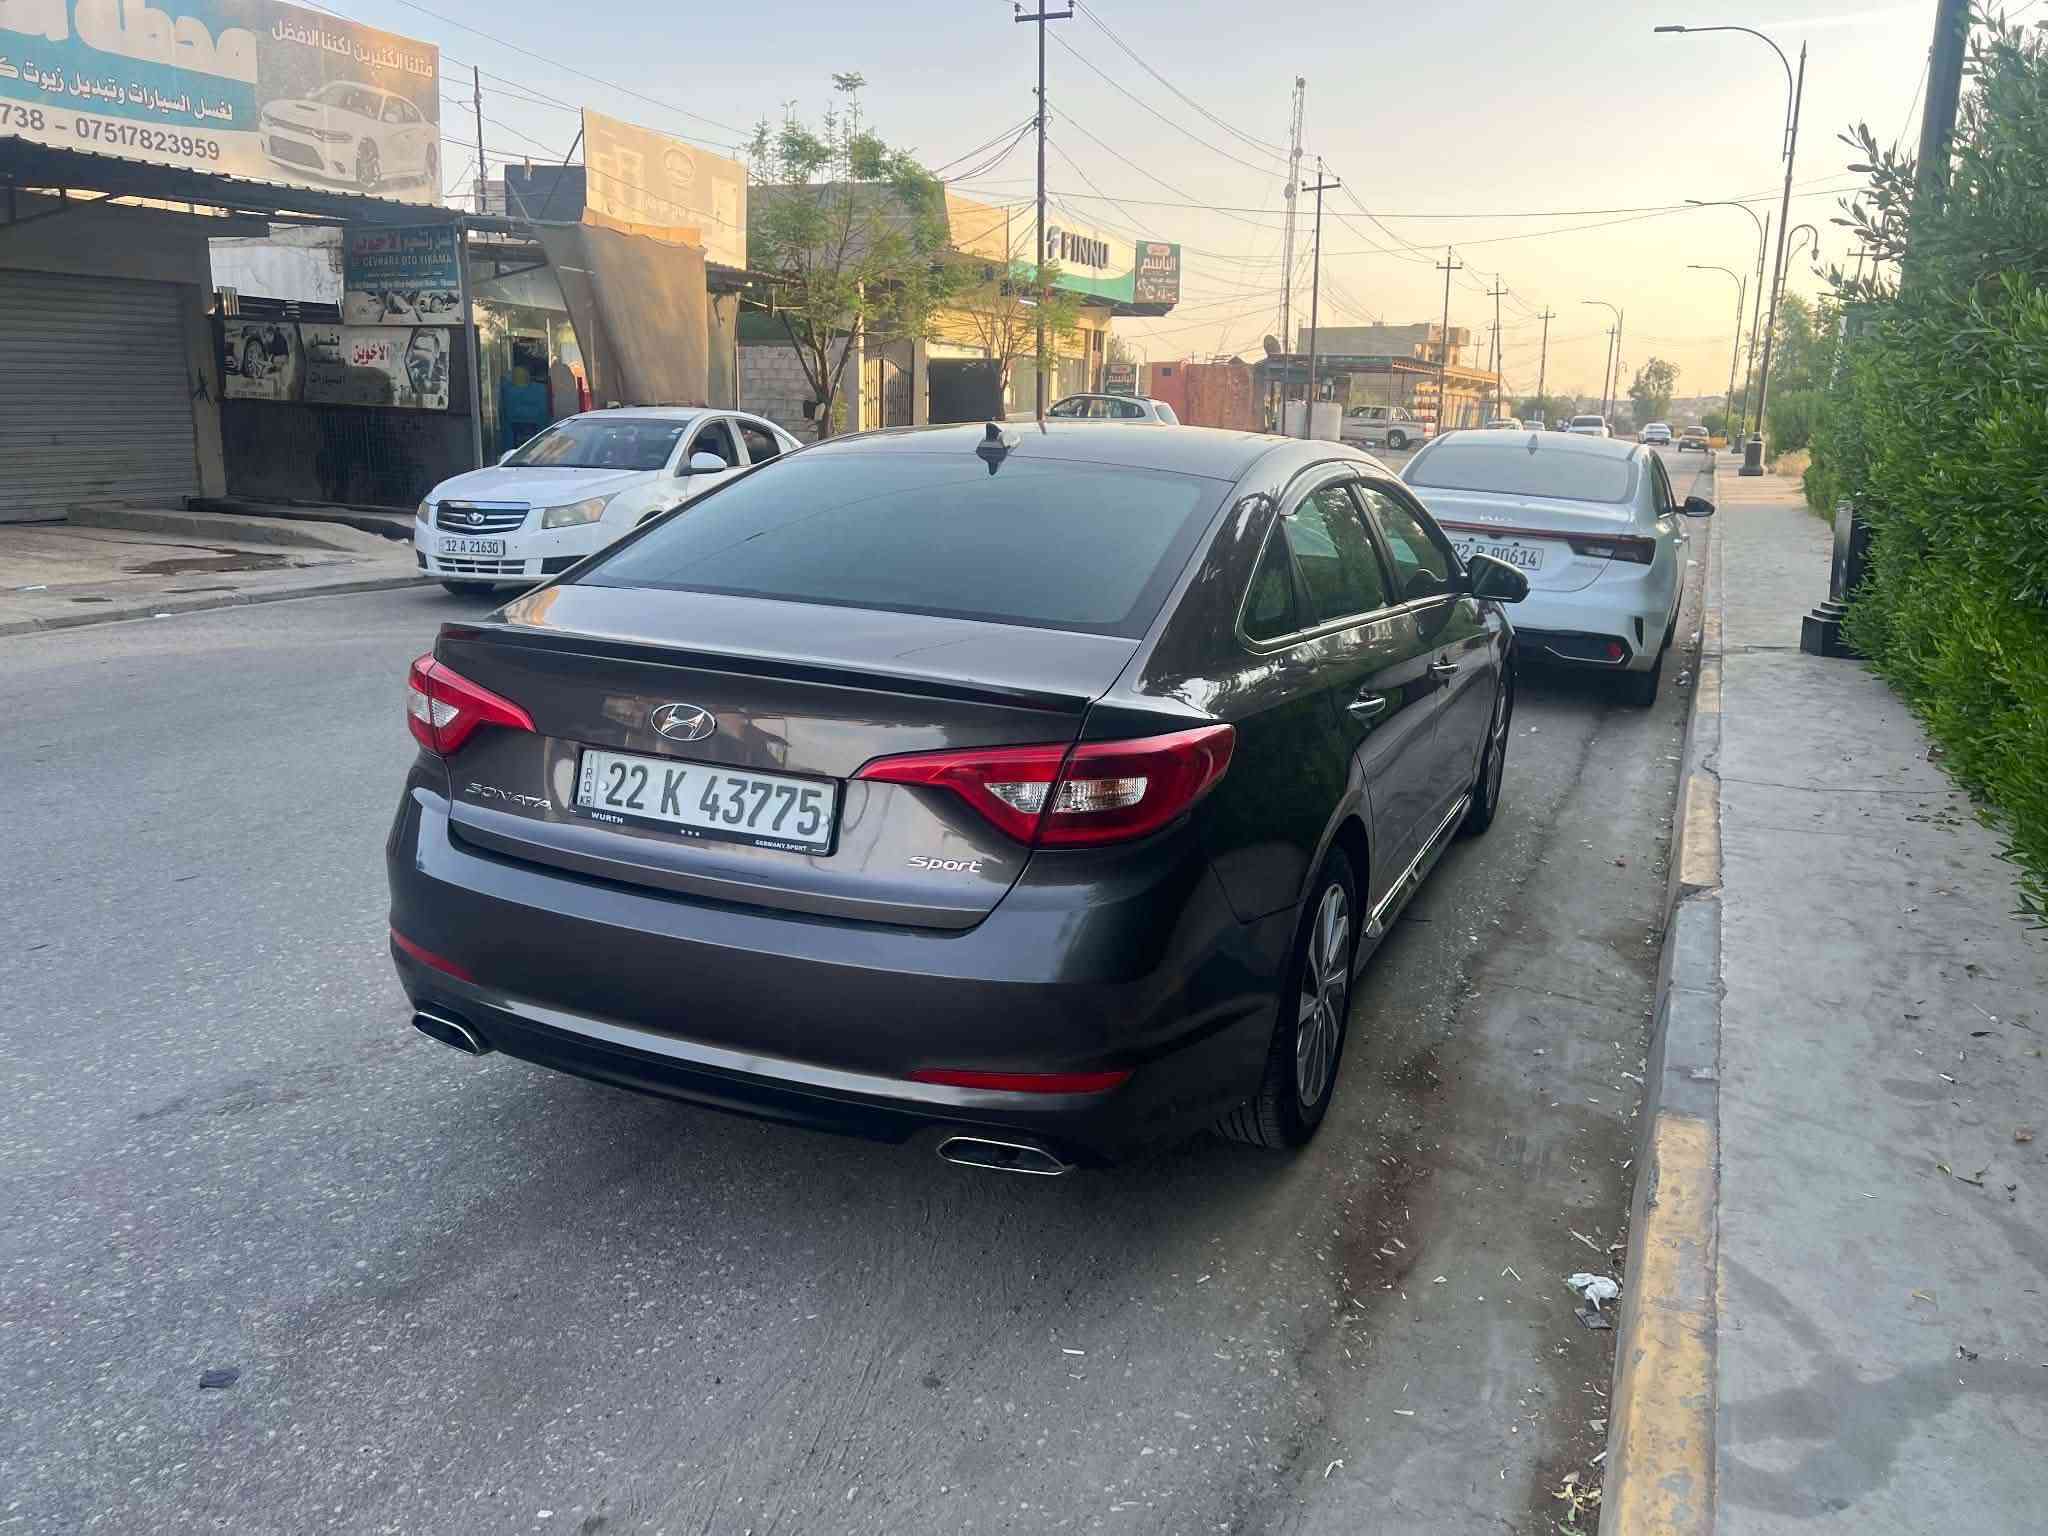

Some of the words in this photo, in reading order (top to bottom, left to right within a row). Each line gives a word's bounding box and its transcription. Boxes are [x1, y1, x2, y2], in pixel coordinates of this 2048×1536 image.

[272, 20, 319, 48] الافضل
[354, 43, 403, 70] الكثيرين
[129, 82, 191, 114] السيارات
[75, 117, 220, 161] 07517823959
[445, 540, 457, 552] 12
[460, 540, 466, 553] A
[469, 541, 499, 554] 21630
[465, 783, 552, 810] SONATA
[606, 762, 648, 810] 22
[660, 768, 687, 816] K
[699, 775, 823, 836] 43775
[906, 856, 983, 873] Sport
